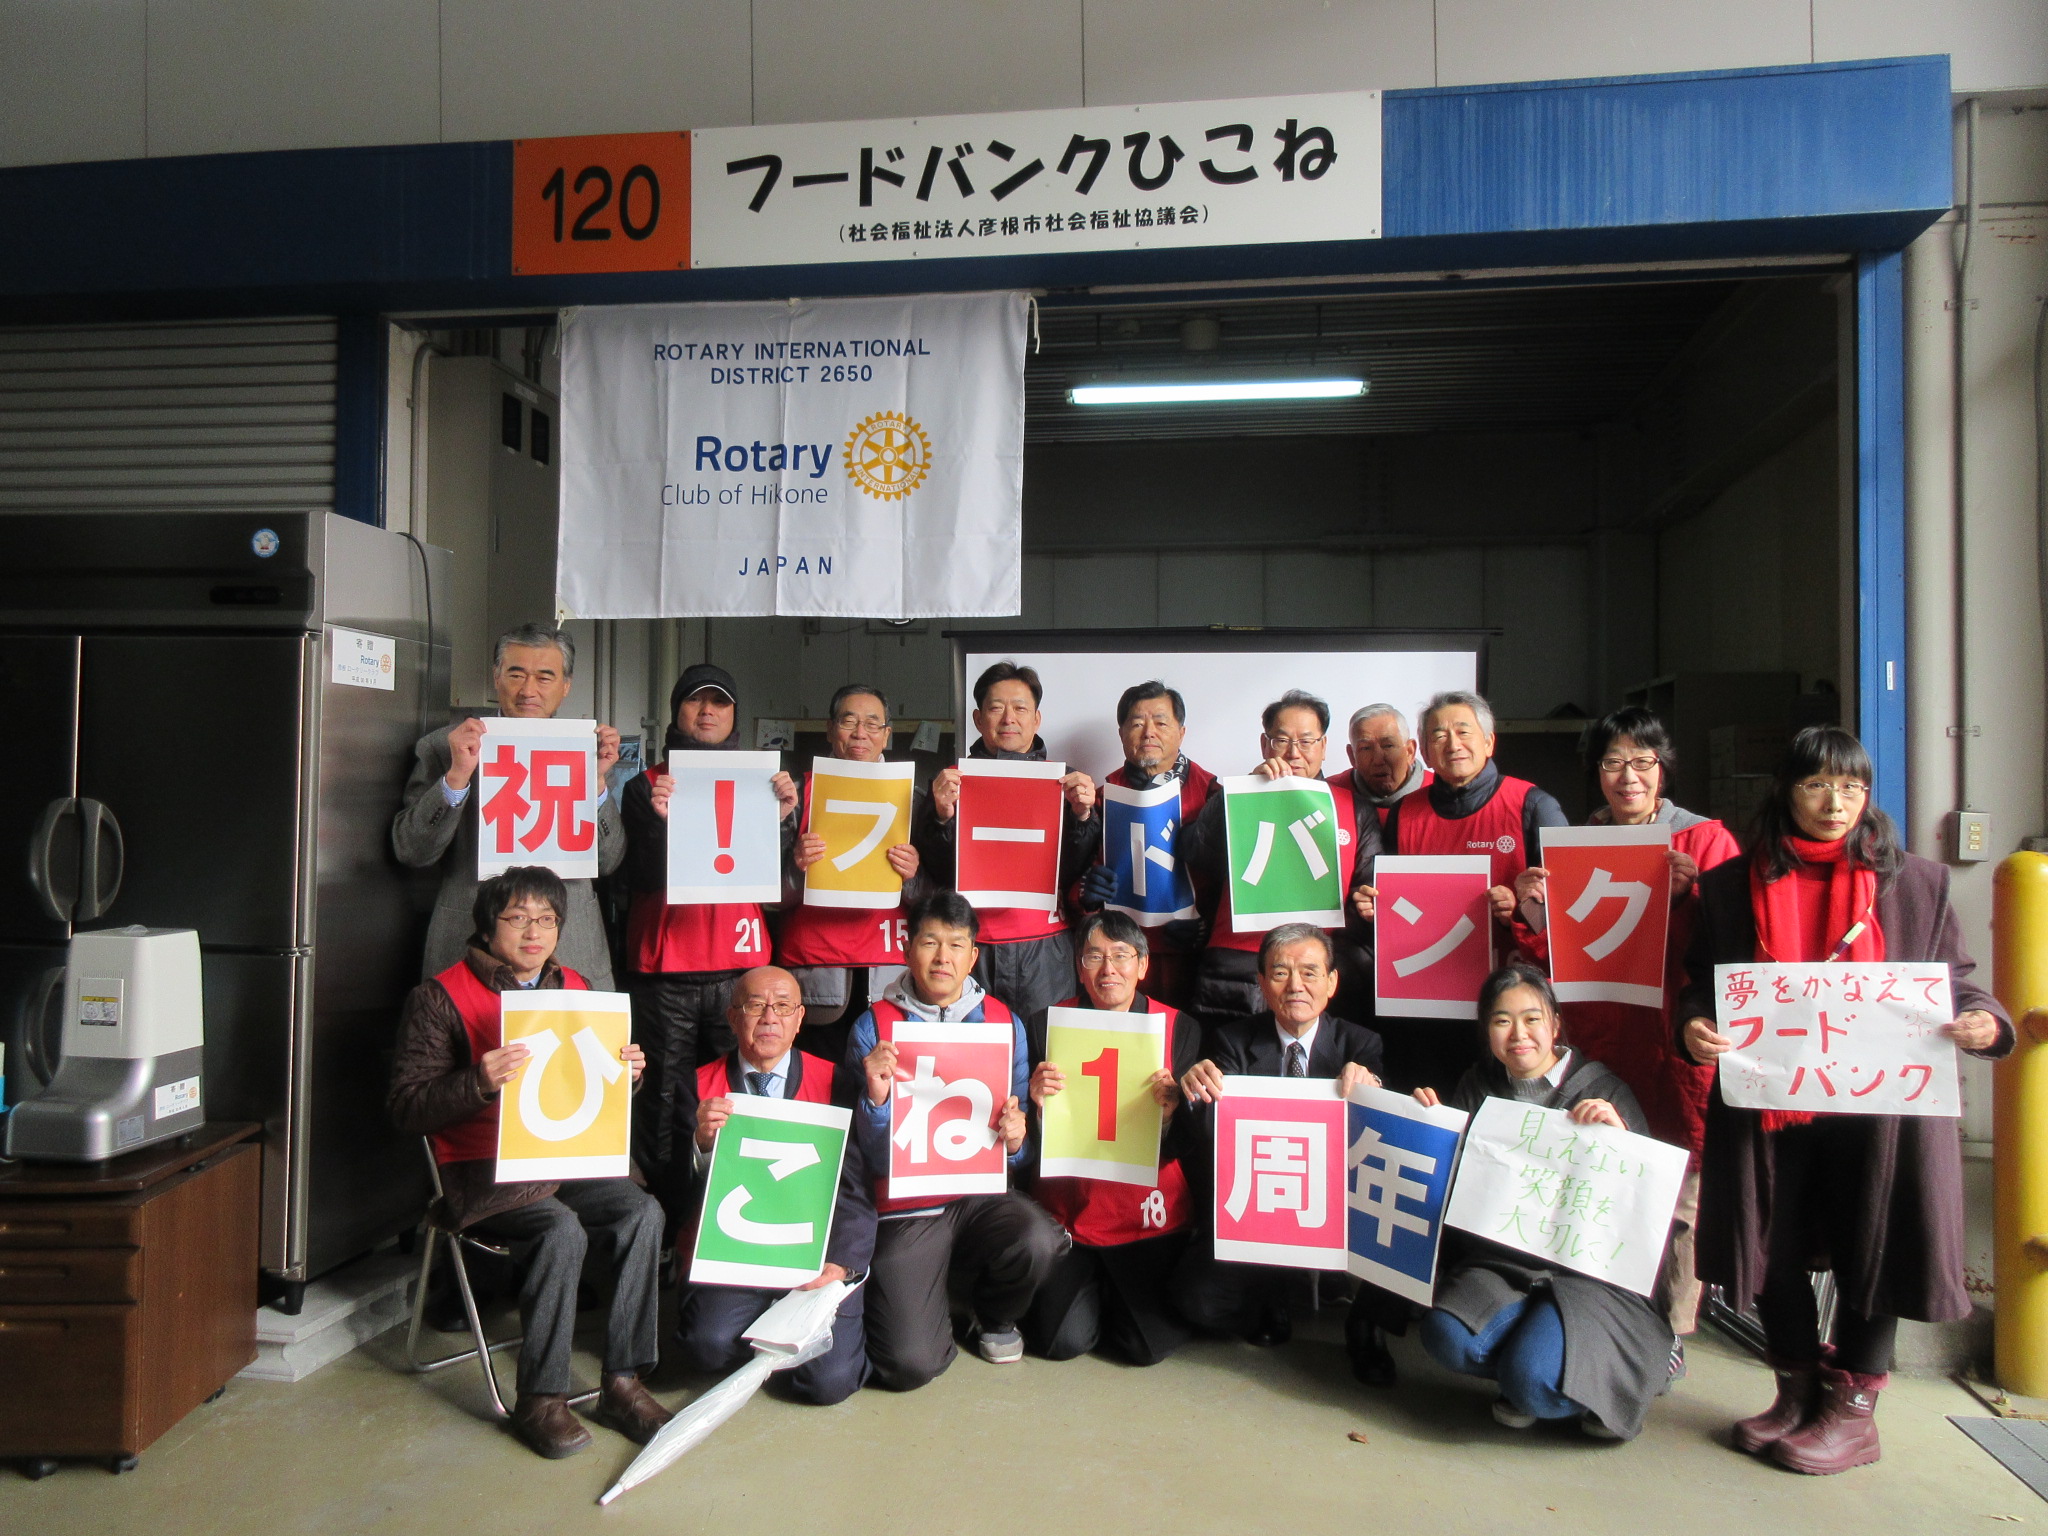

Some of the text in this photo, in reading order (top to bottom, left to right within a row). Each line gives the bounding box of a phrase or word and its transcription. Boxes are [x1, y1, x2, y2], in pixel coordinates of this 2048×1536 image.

[727, 119, 1338, 214] フードバンクひこね
[541, 163, 661, 243] 120
[654, 339, 931, 361] ROTARY INTERNATIONAL
[711, 365, 872, 384] DISTRICT 2650
[695, 435, 833, 479] Rotary
[870, 420, 908, 431] ROTARY
[661, 483, 828, 506] Club of Hikone
[857, 469, 920, 492] INTERNATIONAL
[739, 556, 832, 576] JAPAN
[360, 654, 379, 668] Rotary
[481, 745, 595, 853] 祝
[714, 780, 735, 874] !
[825, 799, 898, 872] フ
[1130, 818, 1175, 897] ド
[1241, 809, 1330, 886] バ
[1466, 839, 1495, 850] Rotary
[734, 918, 762, 953] 21
[1391, 896, 1475, 978] ン
[1566, 867, 1651, 961] ク
[1725, 971, 1943, 1010] 夢をかなえて
[1728, 1011, 1856, 1054] フード
[509, 1026, 623, 1142] ひ
[892, 1056, 999, 1164] ね
[1081, 1047, 1119, 1142] 1
[1787, 1061, 1932, 1101] バンク
[1223, 1118, 1328, 1229] 周
[1505, 1109, 1645, 1178] 見えない
[716, 1138, 821, 1245] こ
[1140, 1189, 1167, 1229] 18
[1348, 1126, 1437, 1248] 年
[1517, 1163, 1614, 1228] 笑顔を
